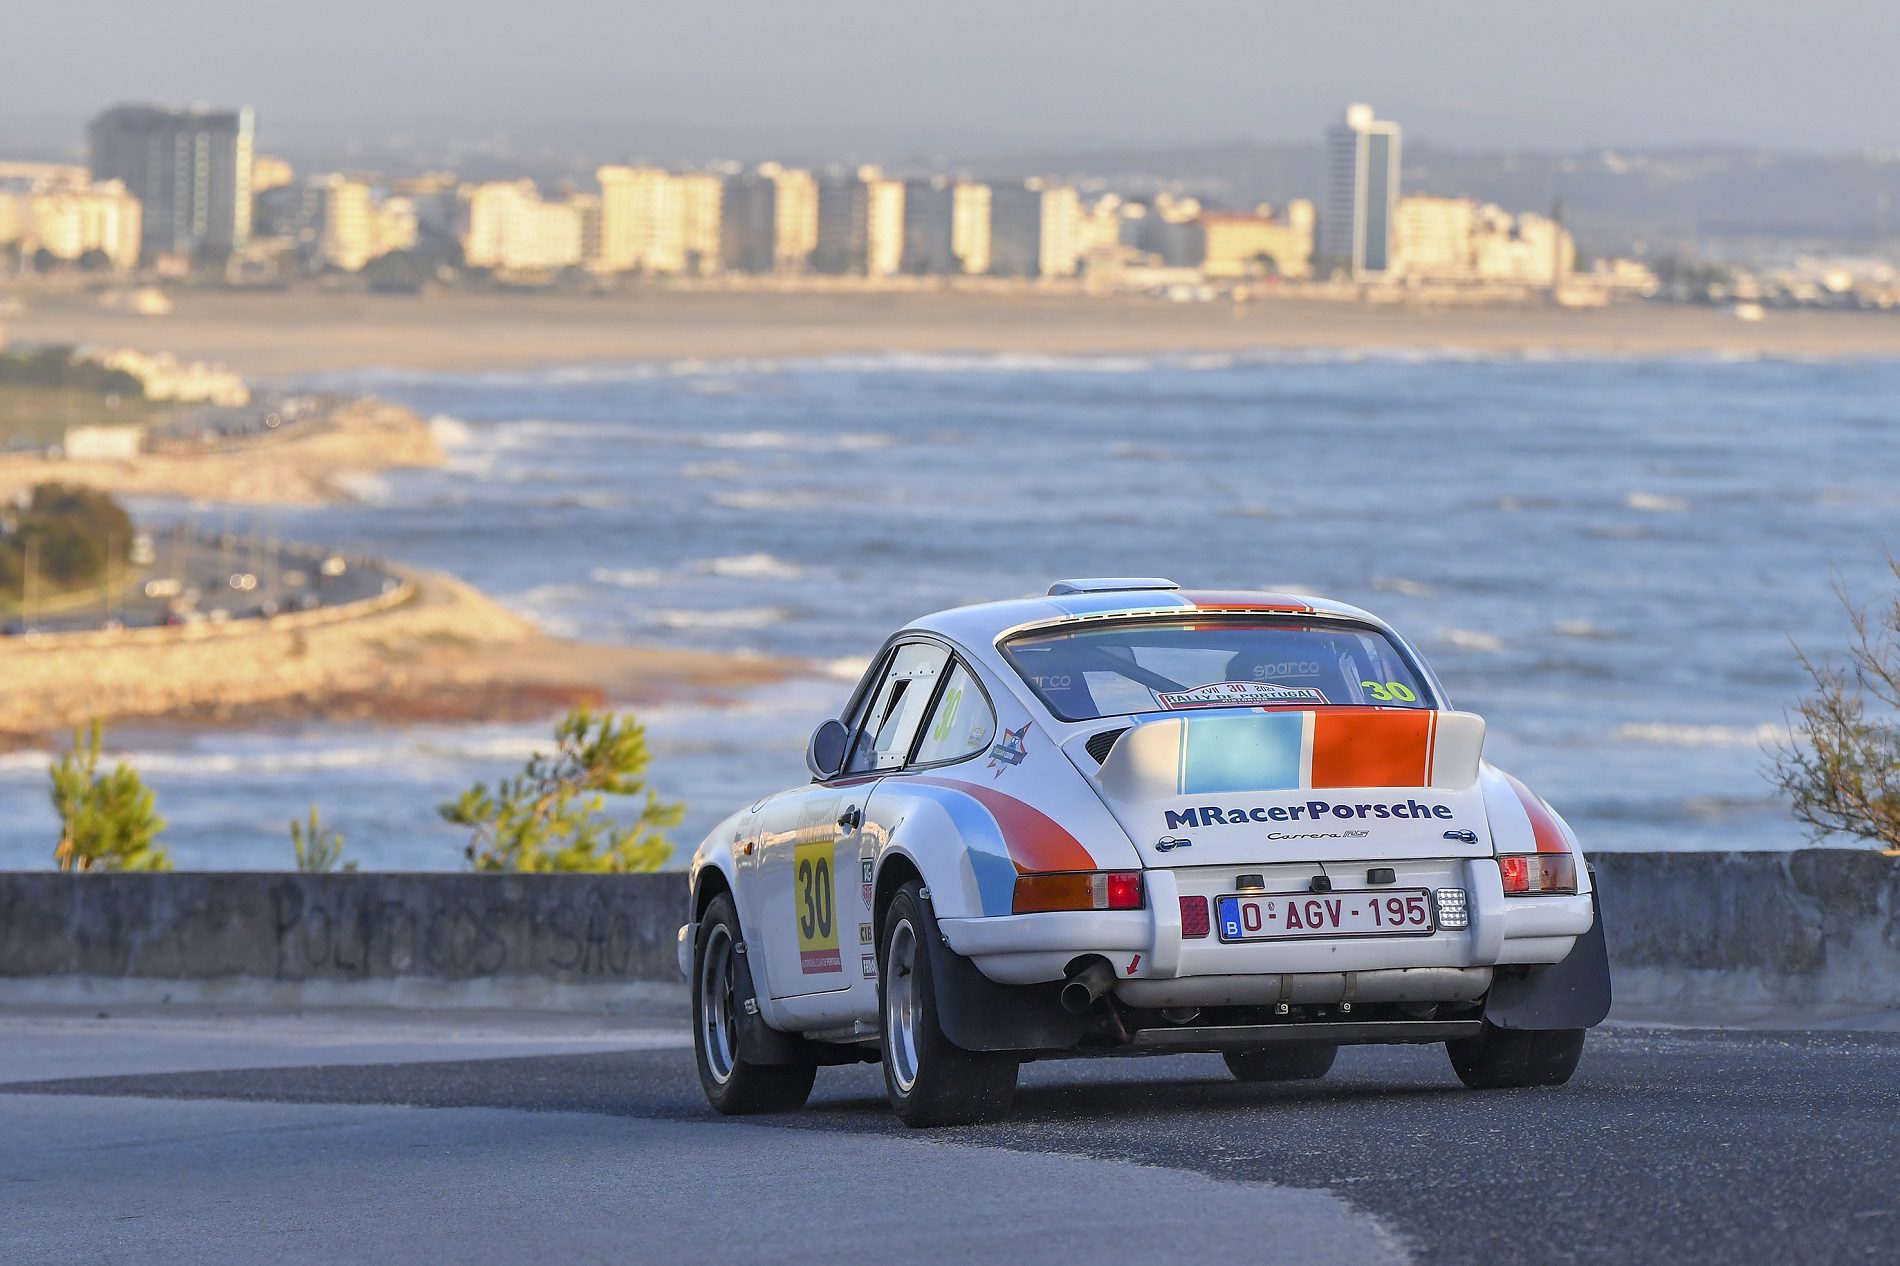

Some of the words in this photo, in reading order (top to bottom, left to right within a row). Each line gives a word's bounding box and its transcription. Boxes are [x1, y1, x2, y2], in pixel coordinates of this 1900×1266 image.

[1252, 661, 1320, 680] sparco
[1165, 694, 1211, 703] RALLY
[1239, 690, 1313, 699] PORTUGAL
[1226, 684, 1247, 692] 30
[1361, 681, 1416, 702] 30
[1164, 800, 1454, 830] MRacerPorsche
[1266, 832, 1341, 840] Carrera
[799, 857, 832, 941] 30
[1226, 921, 1239, 936] B
